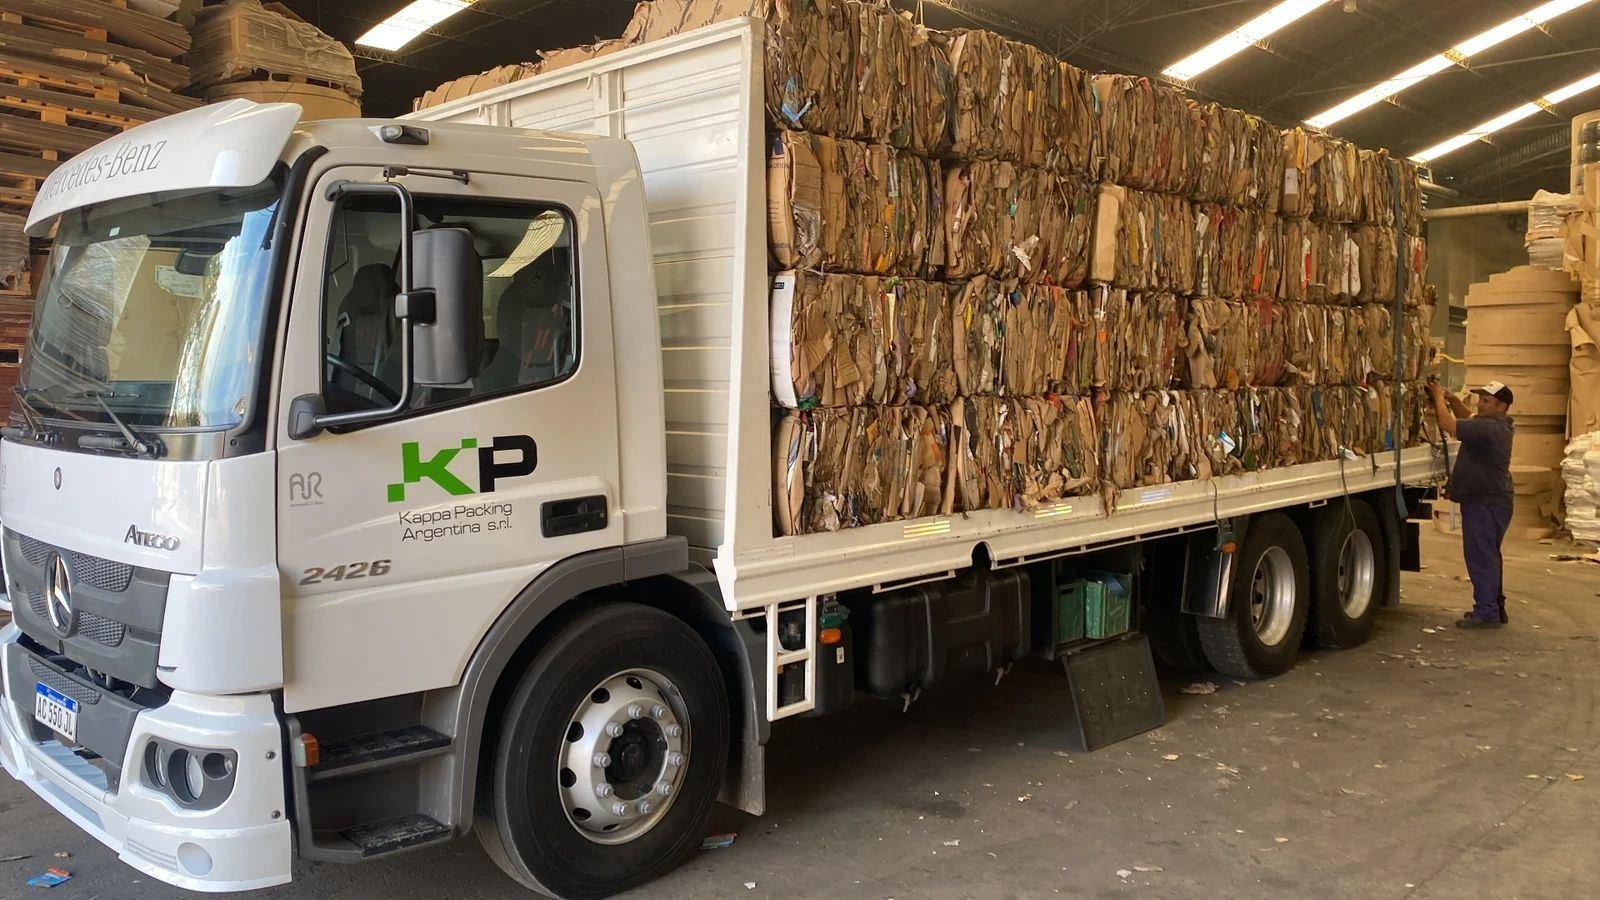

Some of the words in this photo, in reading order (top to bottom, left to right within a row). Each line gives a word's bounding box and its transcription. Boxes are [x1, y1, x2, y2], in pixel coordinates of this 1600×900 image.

[387, 434, 538, 502] KP
[398, 510, 451, 525] Kappa
[454, 502, 513, 518] Packing
[402, 522, 481, 541] Argentina
[487, 516, 512, 531] s.r.l.
[299, 559, 391, 585] 2426
[49, 702, 62, 728] 550
